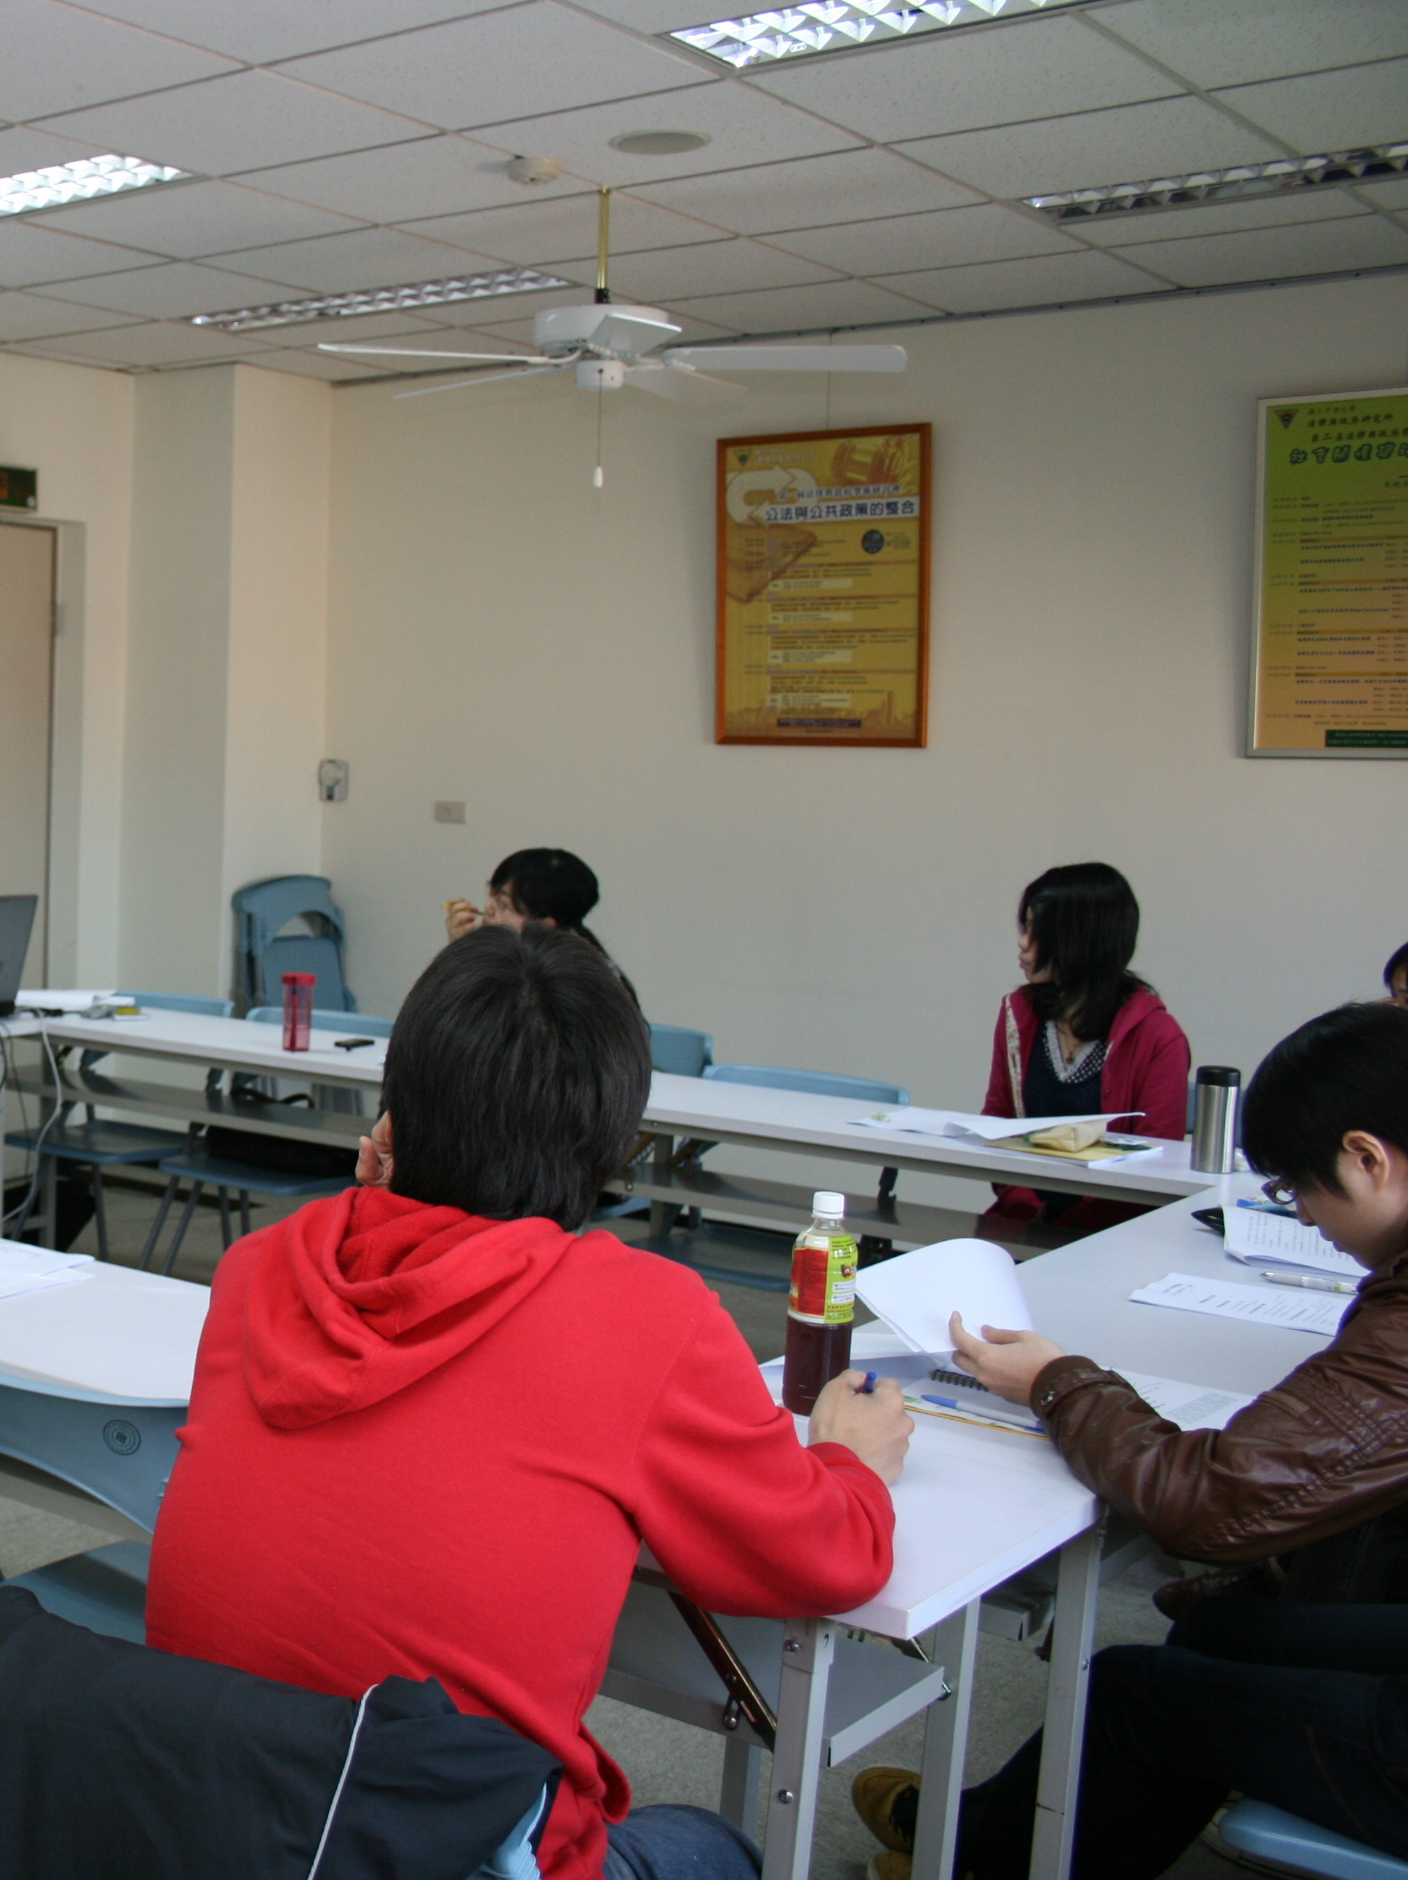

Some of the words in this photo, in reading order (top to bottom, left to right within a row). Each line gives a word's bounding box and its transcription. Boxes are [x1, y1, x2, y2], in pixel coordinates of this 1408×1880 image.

[765, 499, 916, 523] 公法與公共政策的整合
